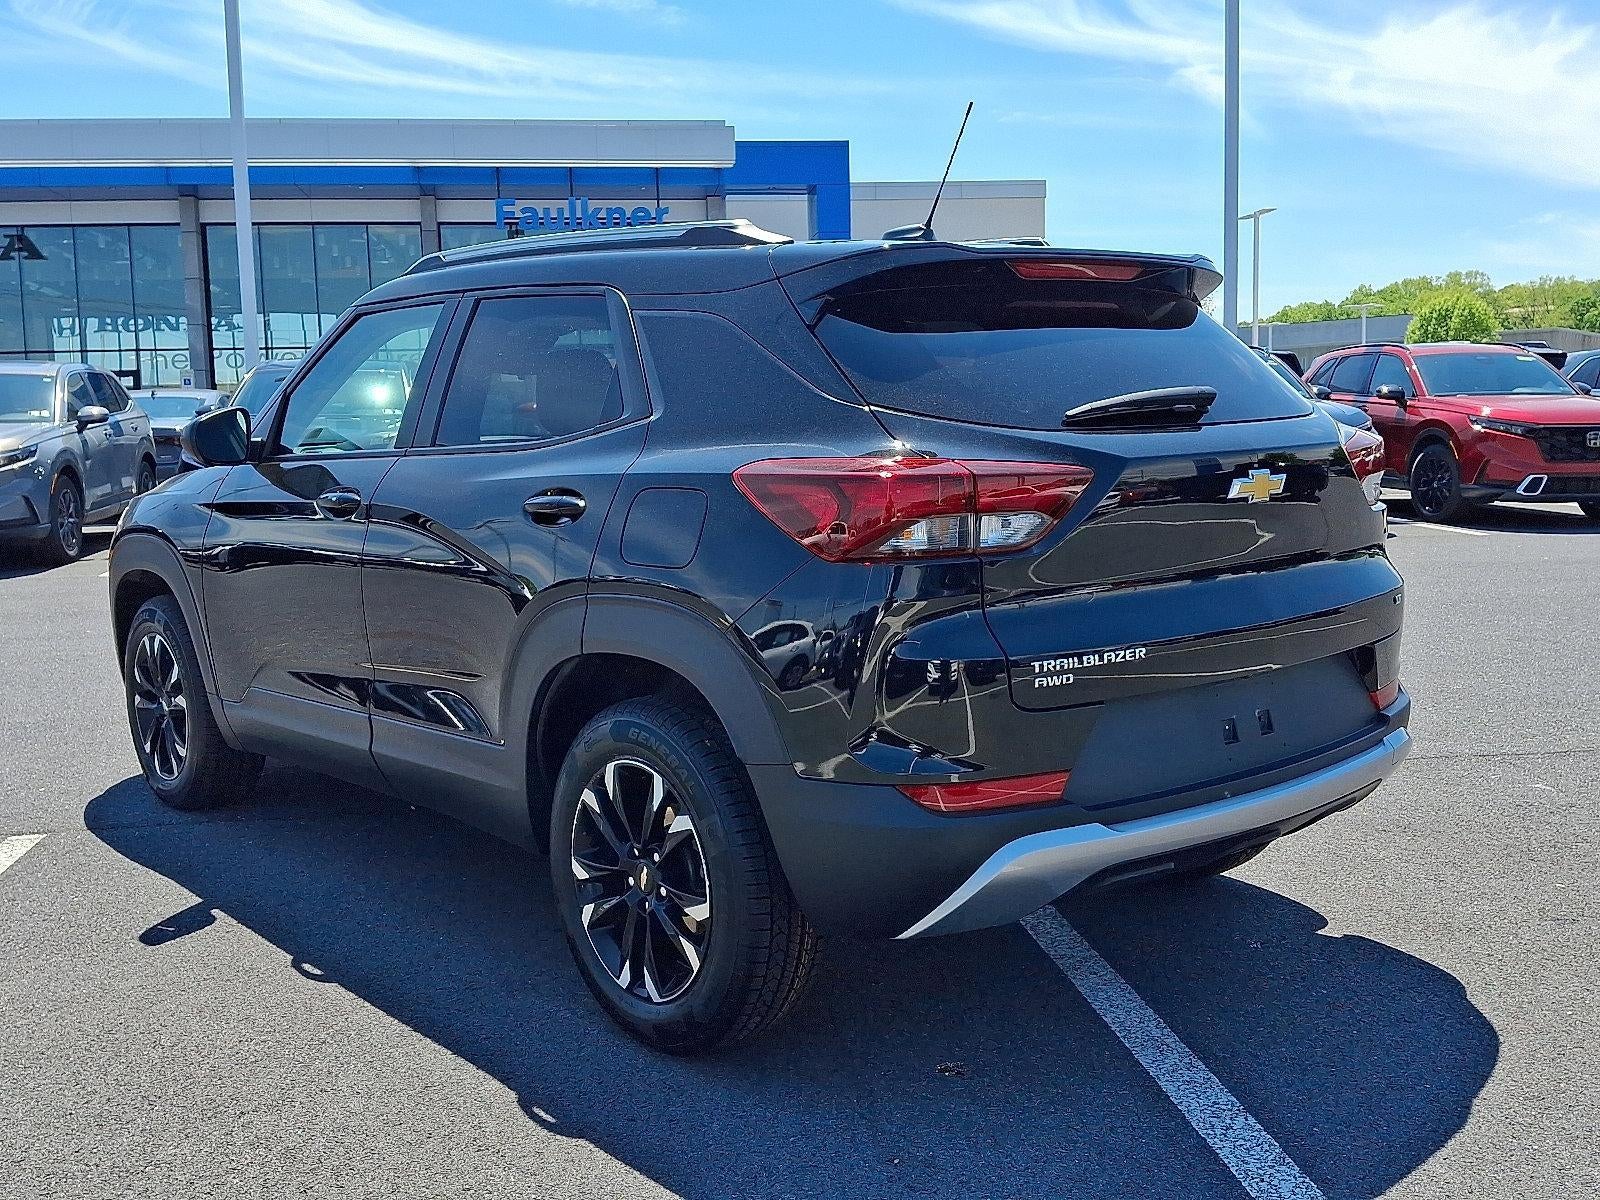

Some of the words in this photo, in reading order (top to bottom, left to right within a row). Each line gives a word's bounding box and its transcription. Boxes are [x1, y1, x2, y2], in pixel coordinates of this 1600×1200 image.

[495, 196, 669, 231] Faulkner
[94, 315, 243, 333] HONA
[1031, 647, 1147, 673] TRAILBLAZER
[1034, 674, 1074, 688] AWD
[627, 727, 695, 795] GENERAL
